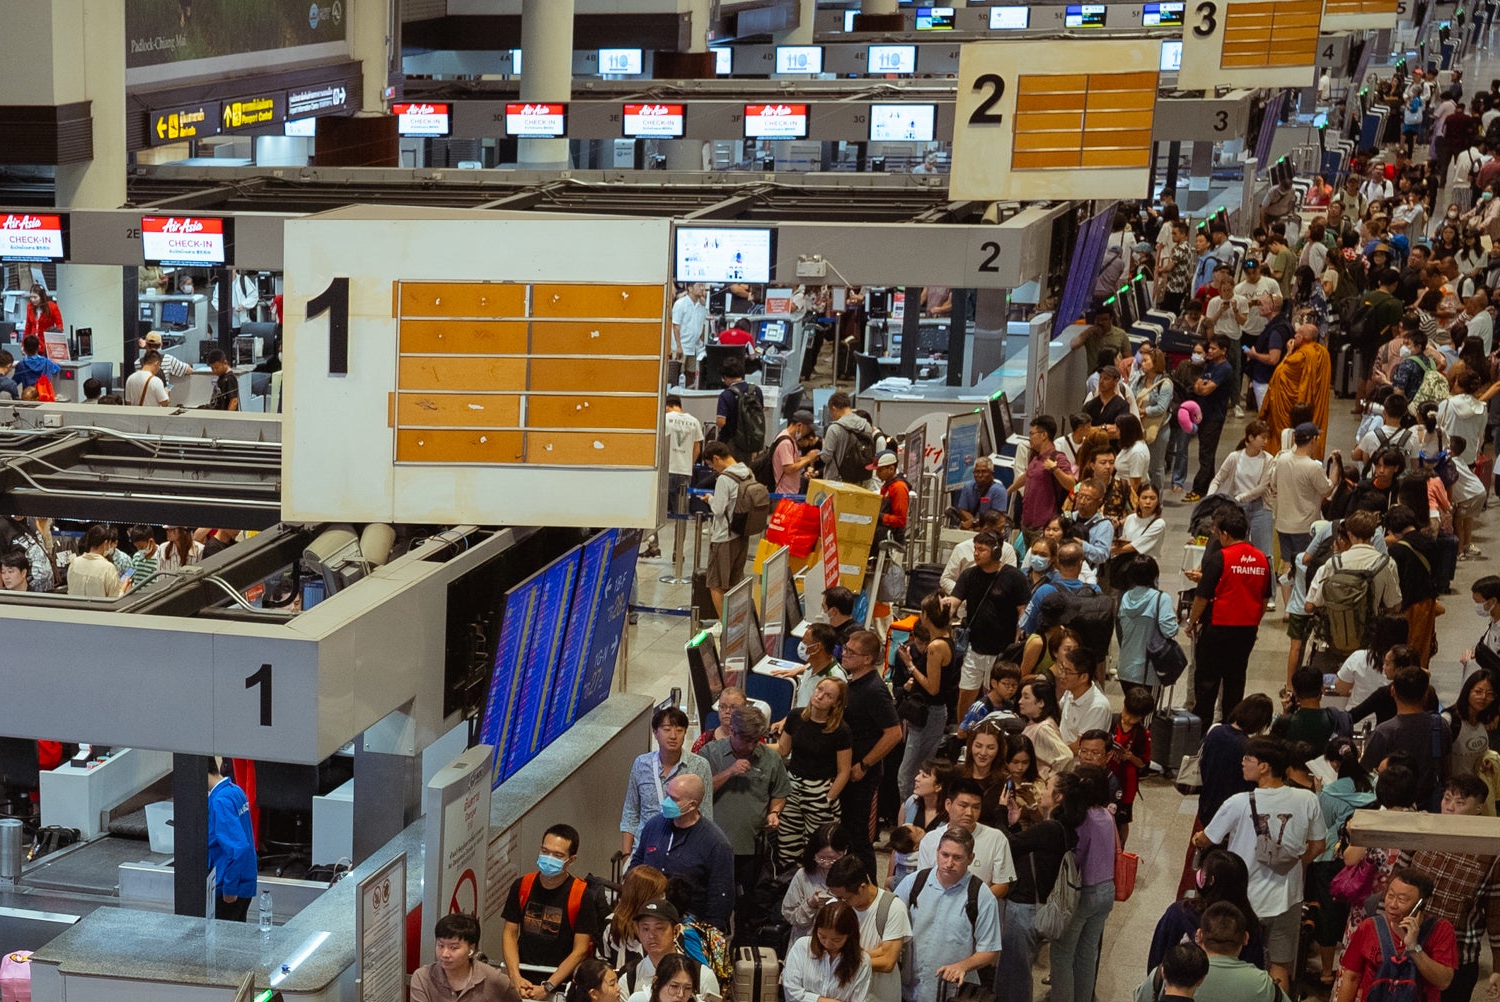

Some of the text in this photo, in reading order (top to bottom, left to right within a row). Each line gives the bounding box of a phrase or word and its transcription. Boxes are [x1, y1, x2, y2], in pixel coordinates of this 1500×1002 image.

[1193, 2, 1217, 37] 3
[1322, 44, 1335, 60] 4
[968, 73, 1006, 125] 2
[1213, 110, 1228, 131] 3
[9, 236, 52, 244] CHECK-IN
[126, 229, 140, 239] 2E
[168, 239, 213, 248] CHECK-IN
[978, 241, 1001, 272] 2
[306, 277, 350, 375] 1
[1231, 565, 1266, 576] TRAINEE
[245, 664, 274, 727] 1
